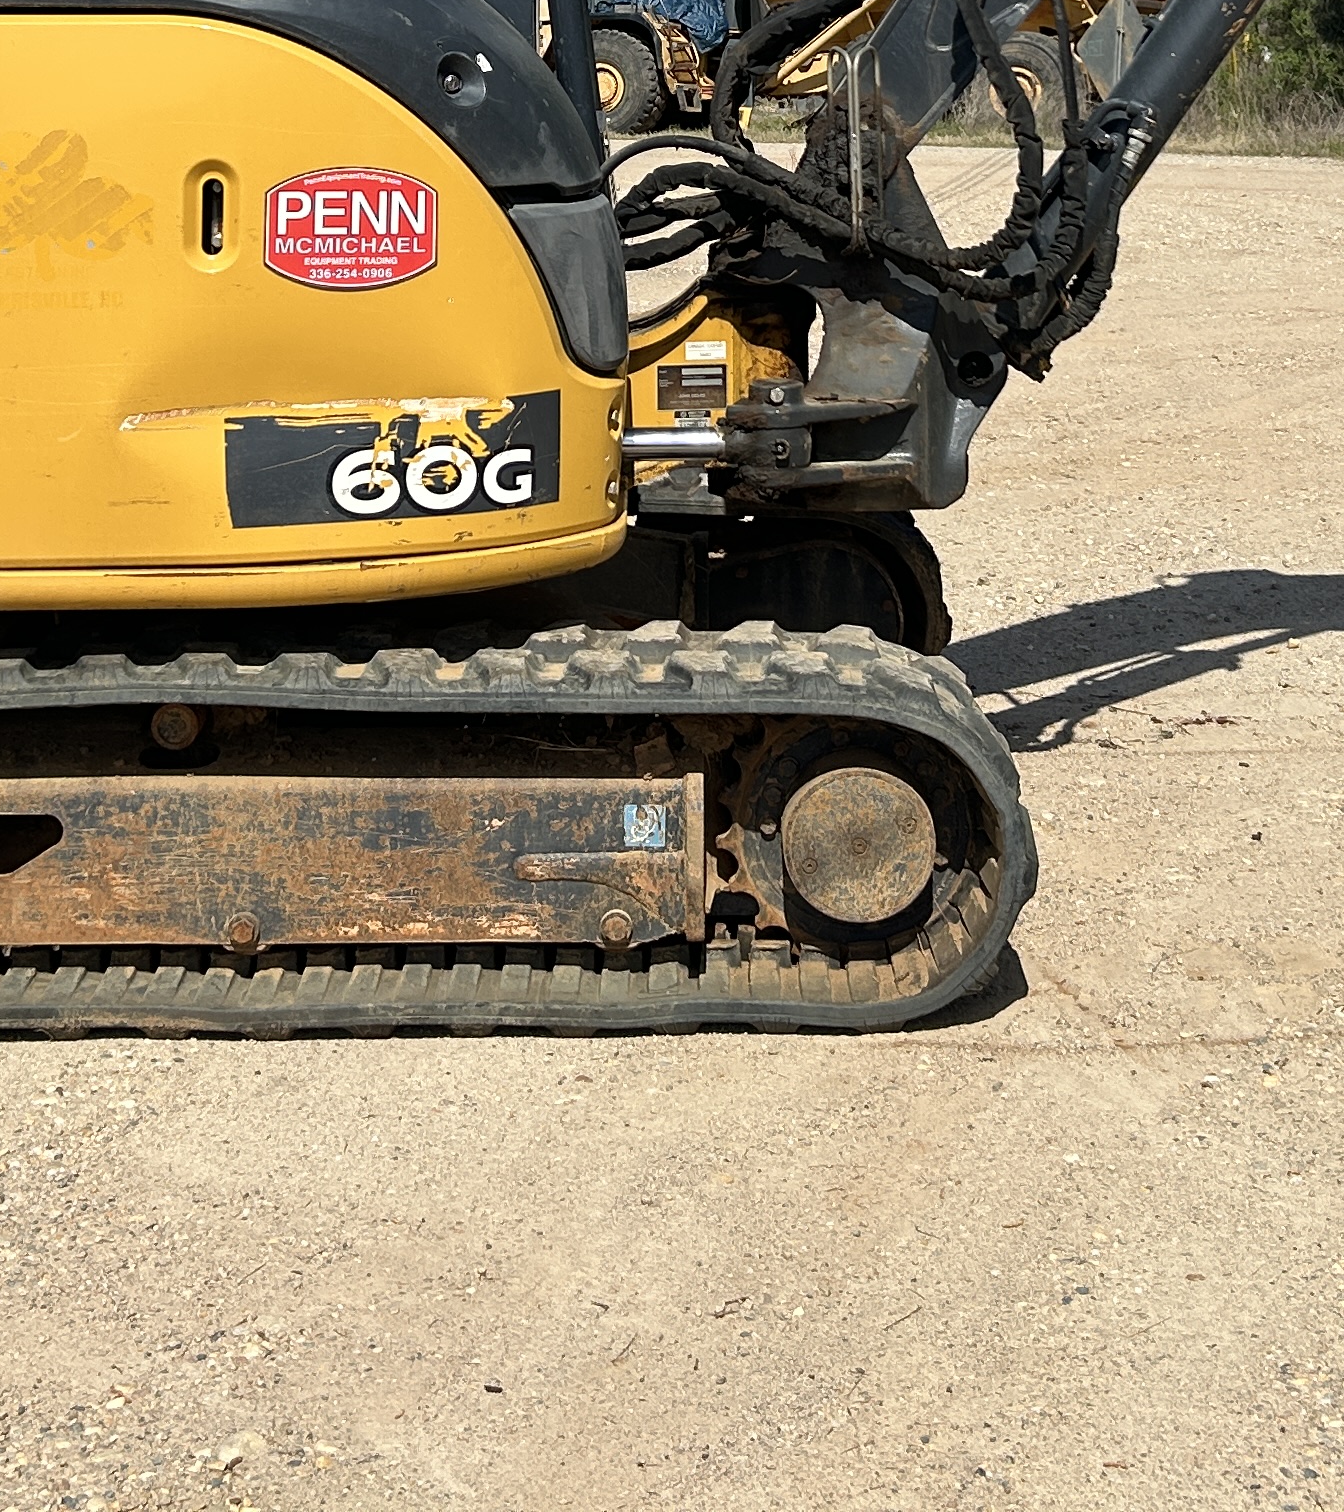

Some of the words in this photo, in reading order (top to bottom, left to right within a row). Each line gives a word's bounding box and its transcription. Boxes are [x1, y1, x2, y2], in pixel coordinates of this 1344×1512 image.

[276, 190, 426, 236] PENN
[274, 237, 427, 254] MCMICHAEL
[303, 256, 356, 266] EQUIPMENT
[358, 256, 398, 265] TRADING
[308, 267, 393, 279] 336-254-0906
[330, 444, 534, 515] 60G
